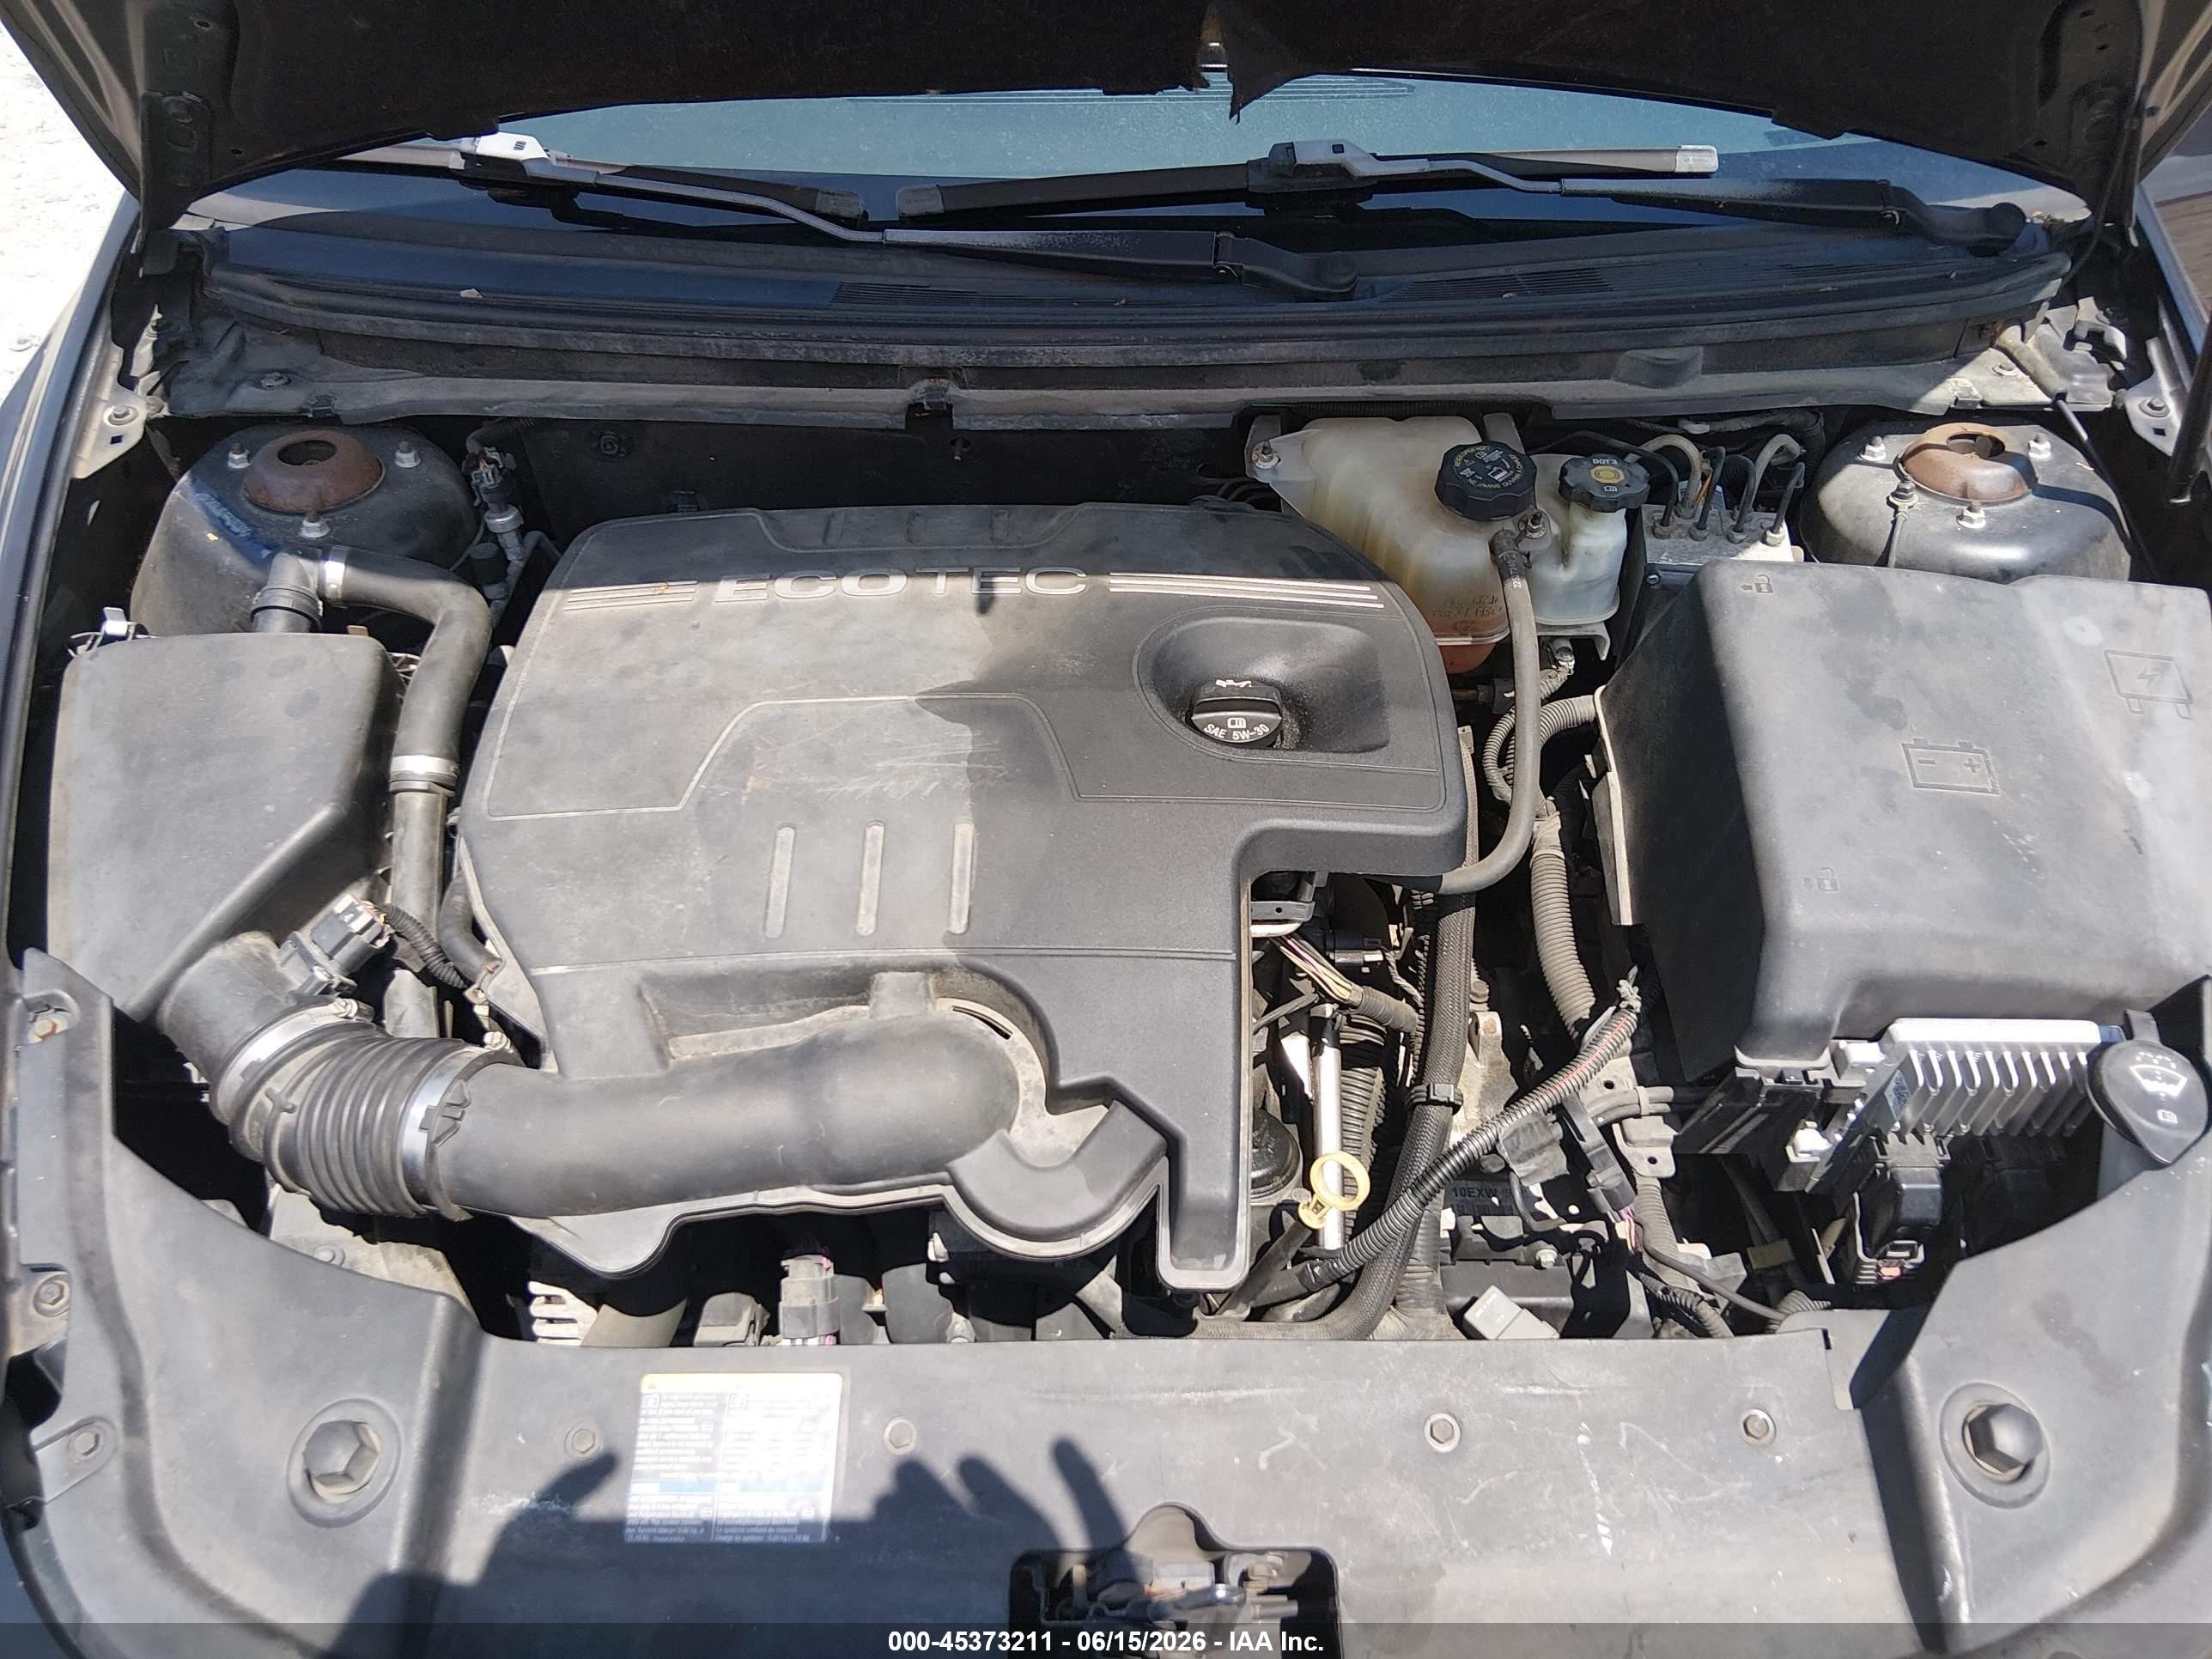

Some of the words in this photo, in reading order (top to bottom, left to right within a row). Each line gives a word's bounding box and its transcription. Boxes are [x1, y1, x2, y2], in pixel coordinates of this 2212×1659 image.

[715, 566, 1087, 604] ECOTEC
[1204, 724, 1227, 738] SAE
[1232, 724, 1269, 740] 5W-30
